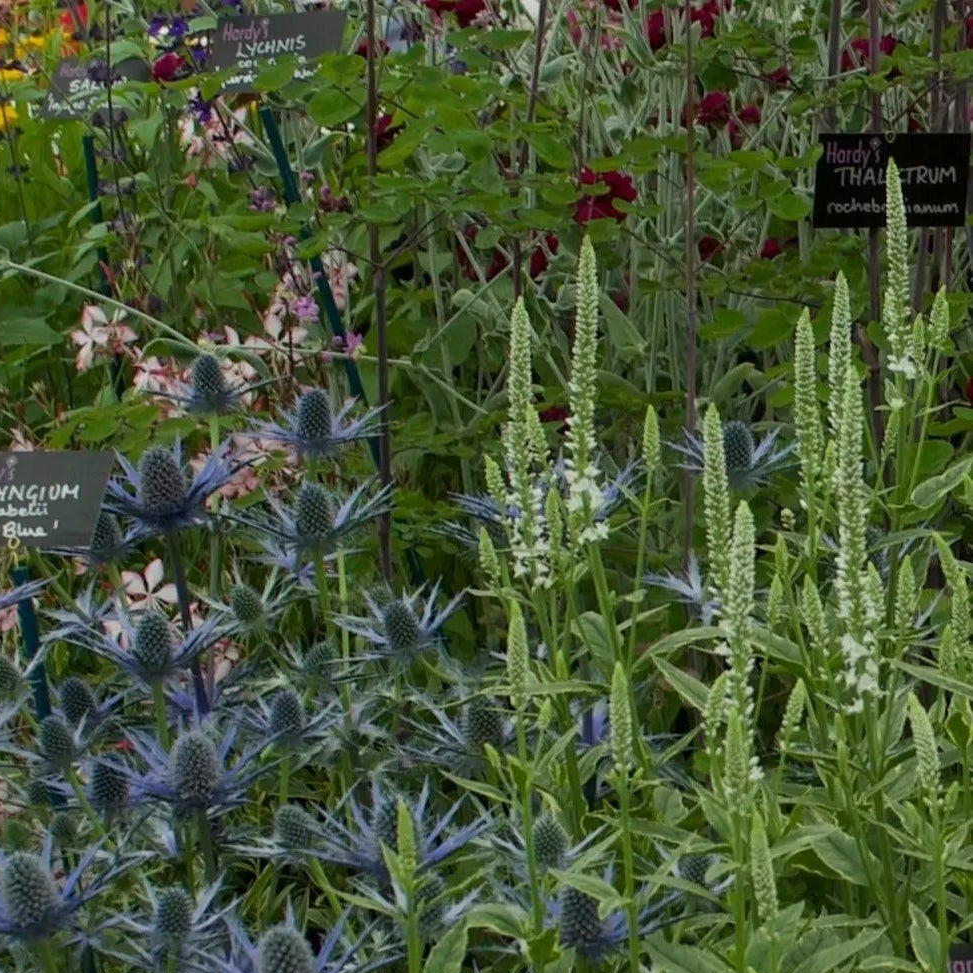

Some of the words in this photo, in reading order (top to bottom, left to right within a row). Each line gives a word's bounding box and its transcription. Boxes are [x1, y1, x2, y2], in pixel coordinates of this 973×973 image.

[236, 34, 307, 58] LYCHNIS
[827, 139, 882, 168] Hardy's
[834, 165, 956, 187] THALCTRUM
